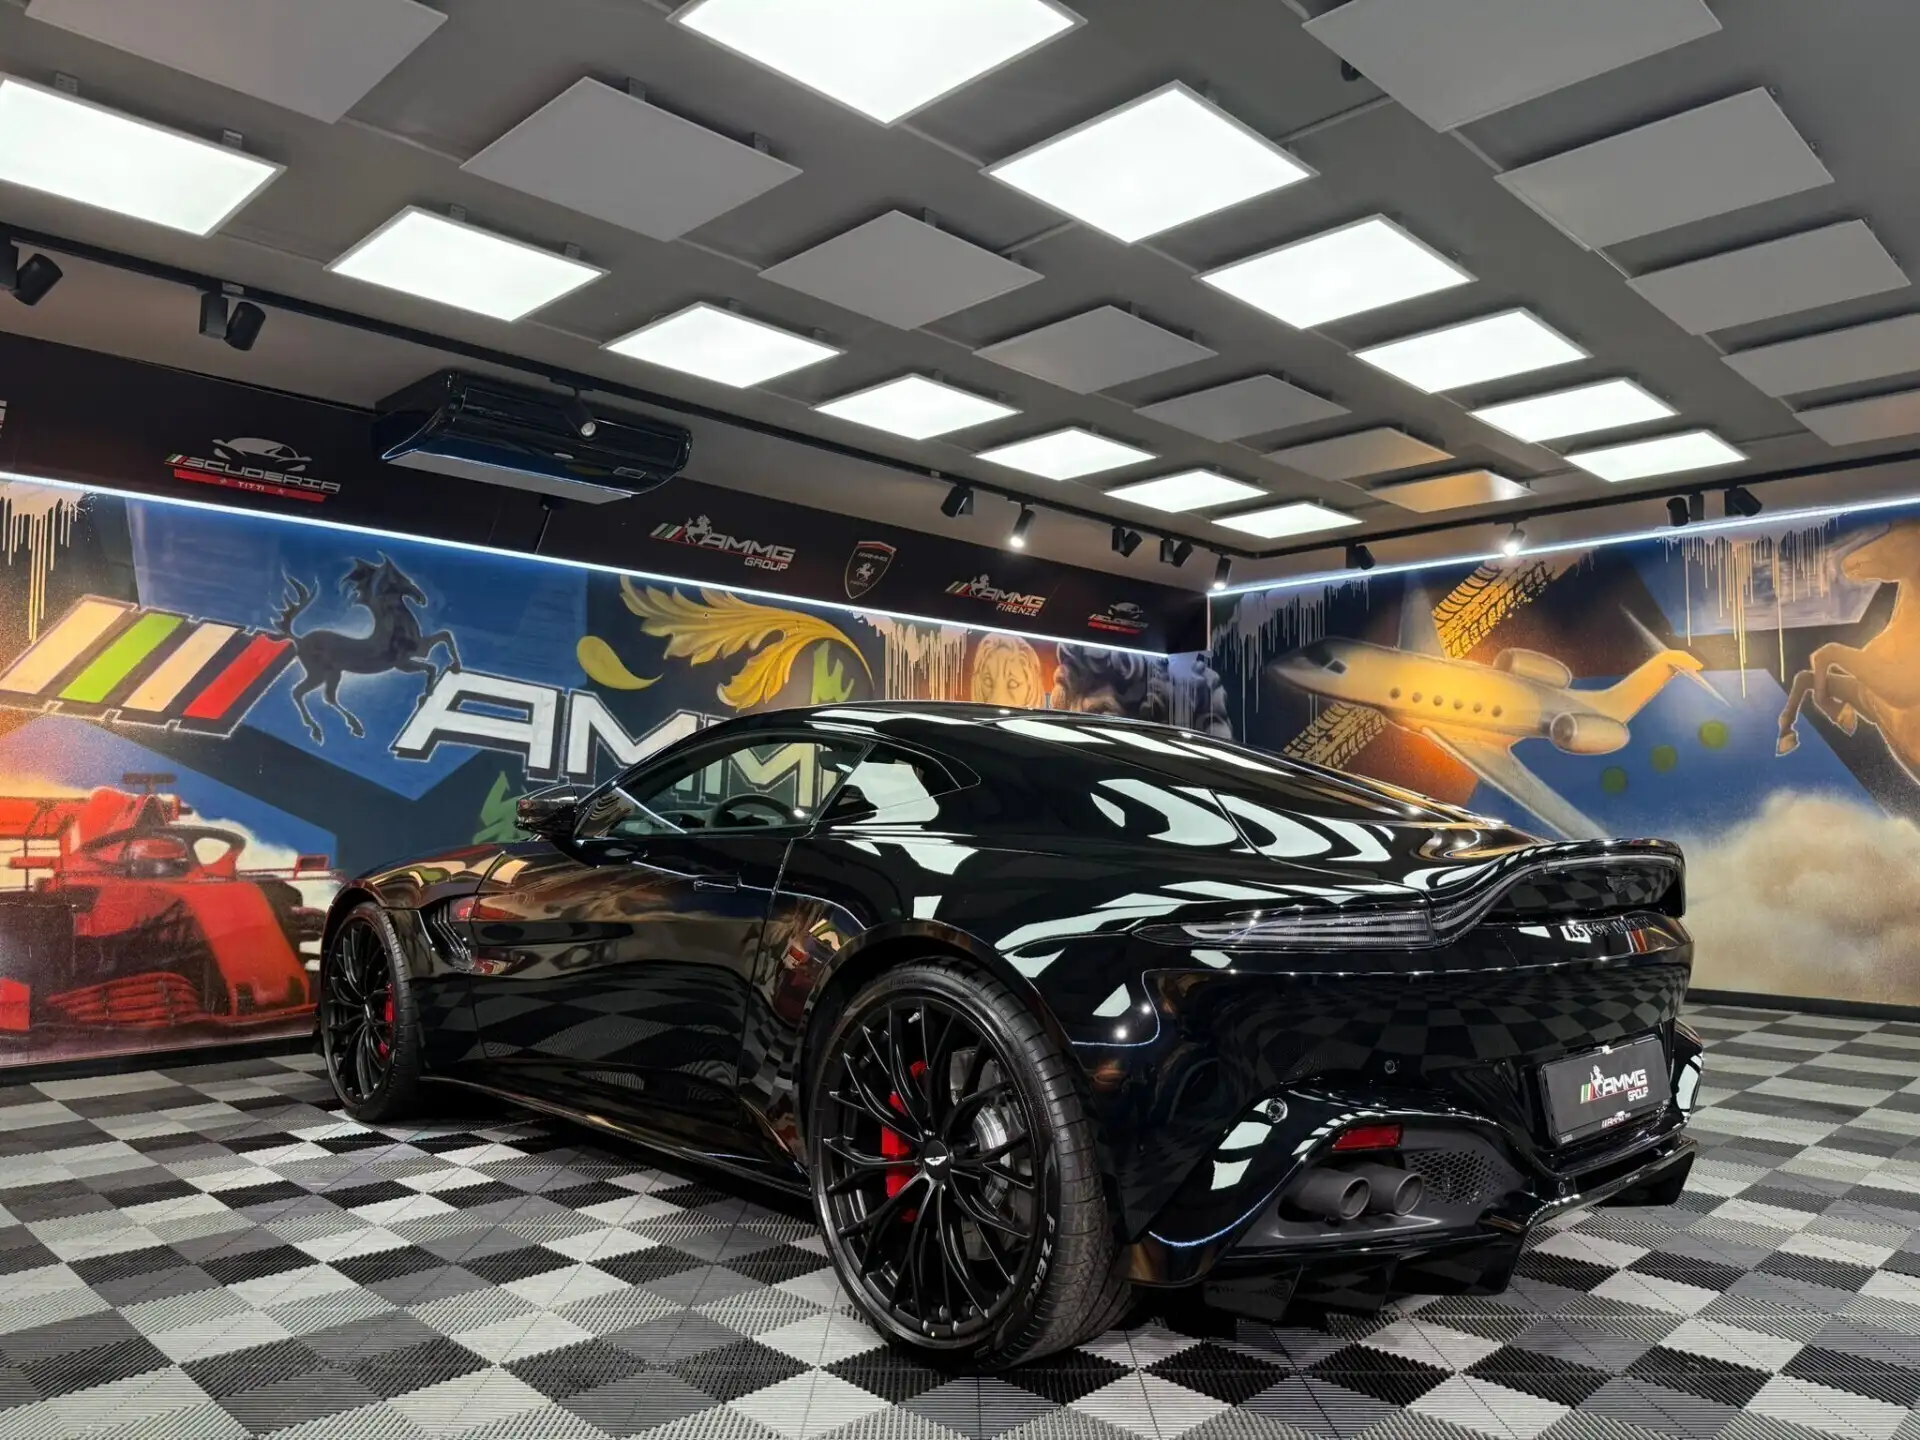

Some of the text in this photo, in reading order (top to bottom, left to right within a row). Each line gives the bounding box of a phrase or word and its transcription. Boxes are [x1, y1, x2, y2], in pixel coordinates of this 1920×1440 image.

[184, 457, 341, 494] SCUDERIA
[698, 533, 796, 562] AMMG
[744, 556, 789, 571] GROUP
[979, 587, 1047, 607] AMMG
[996, 602, 1040, 617] FIRENZE
[1602, 1068, 1648, 1096] AMMG
[1627, 1085, 1649, 1102] GROUP
